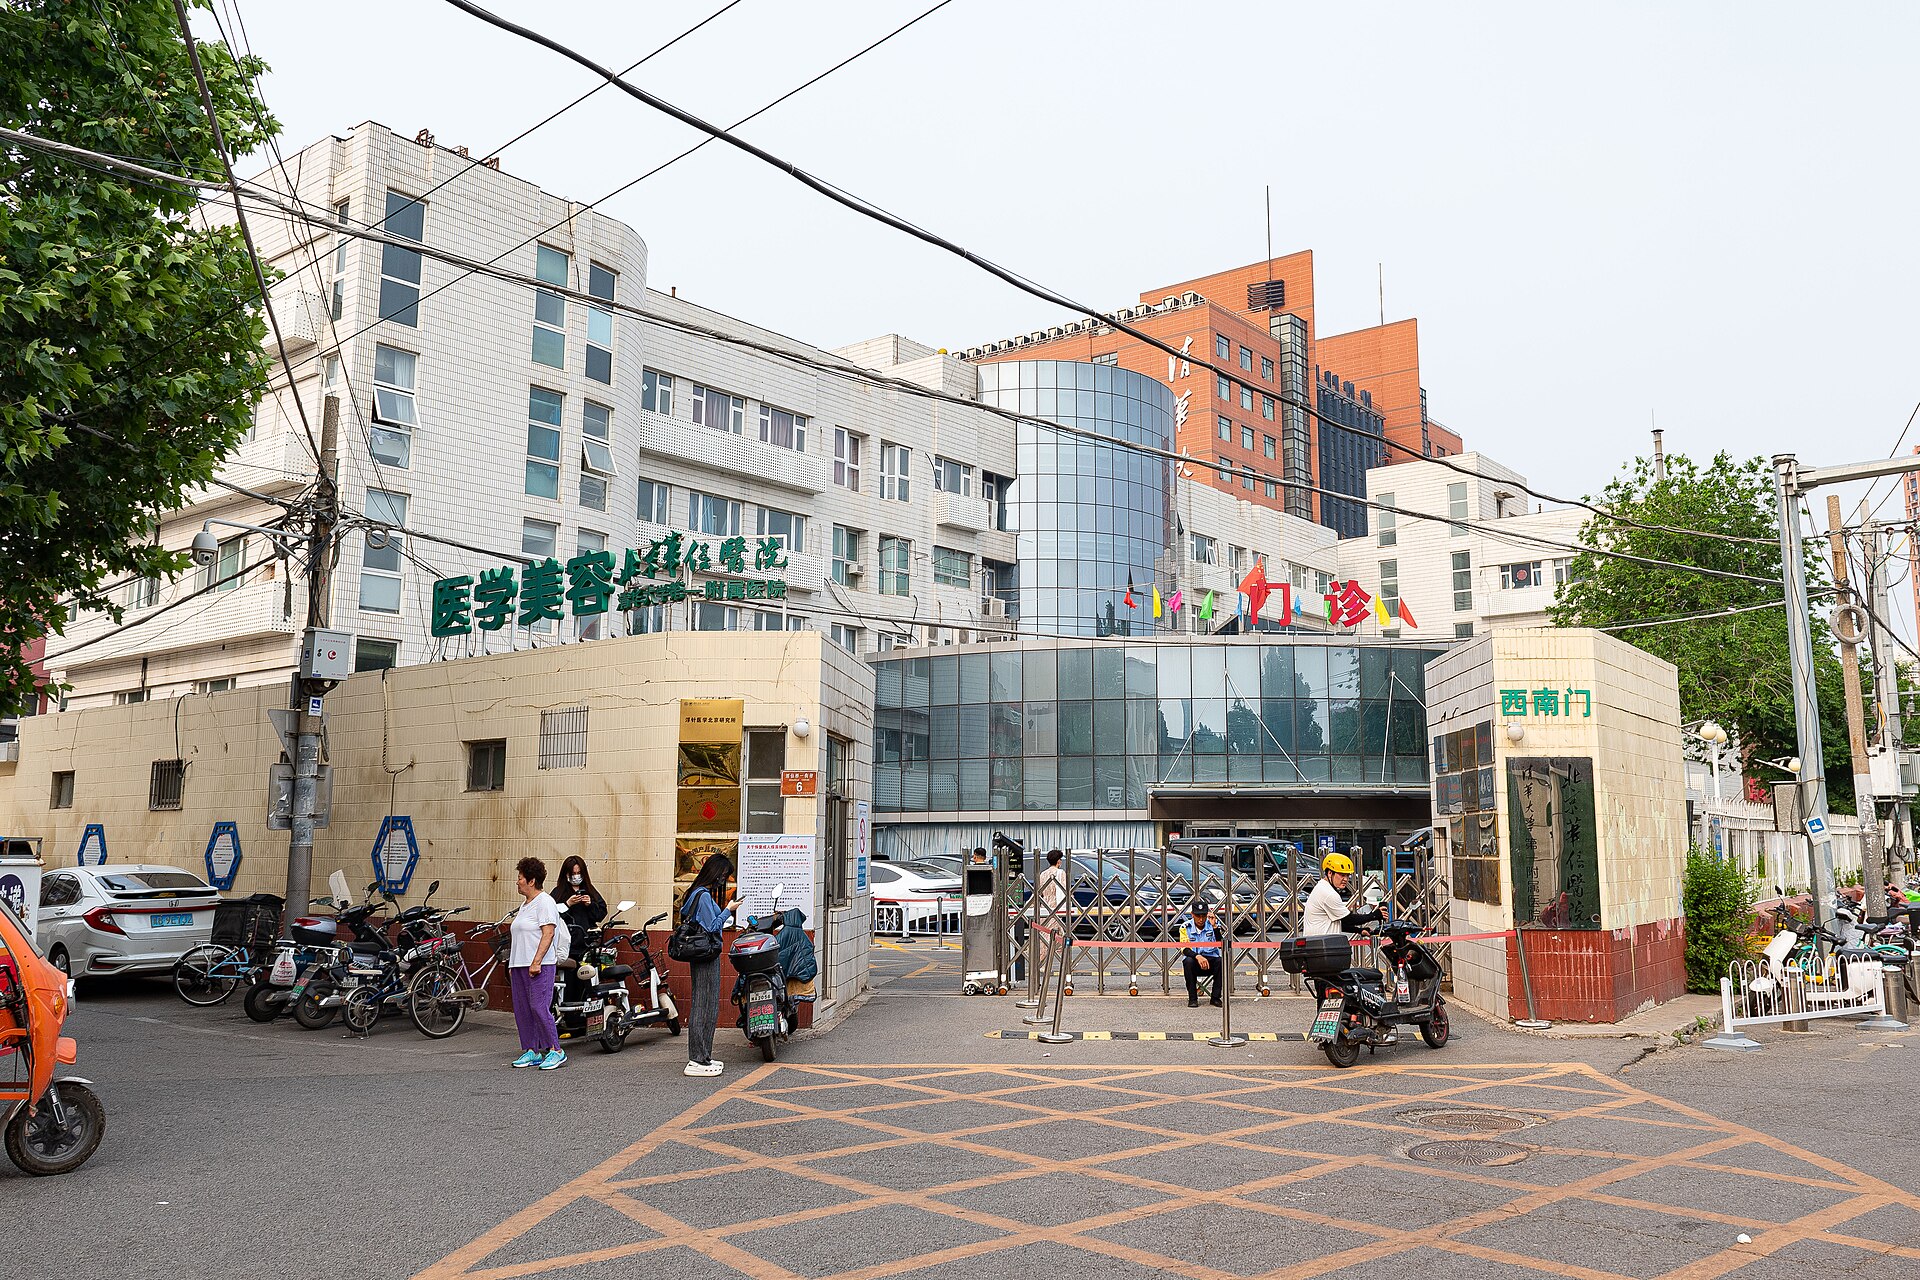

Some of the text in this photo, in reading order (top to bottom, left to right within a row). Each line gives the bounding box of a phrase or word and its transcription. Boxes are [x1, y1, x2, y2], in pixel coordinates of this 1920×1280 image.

[431, 550, 616, 637] 医学美容
[1250, 579, 1372, 628] 门诊
[1500, 687, 1591, 718] 西南门
[796, 781, 803, 792] 6
